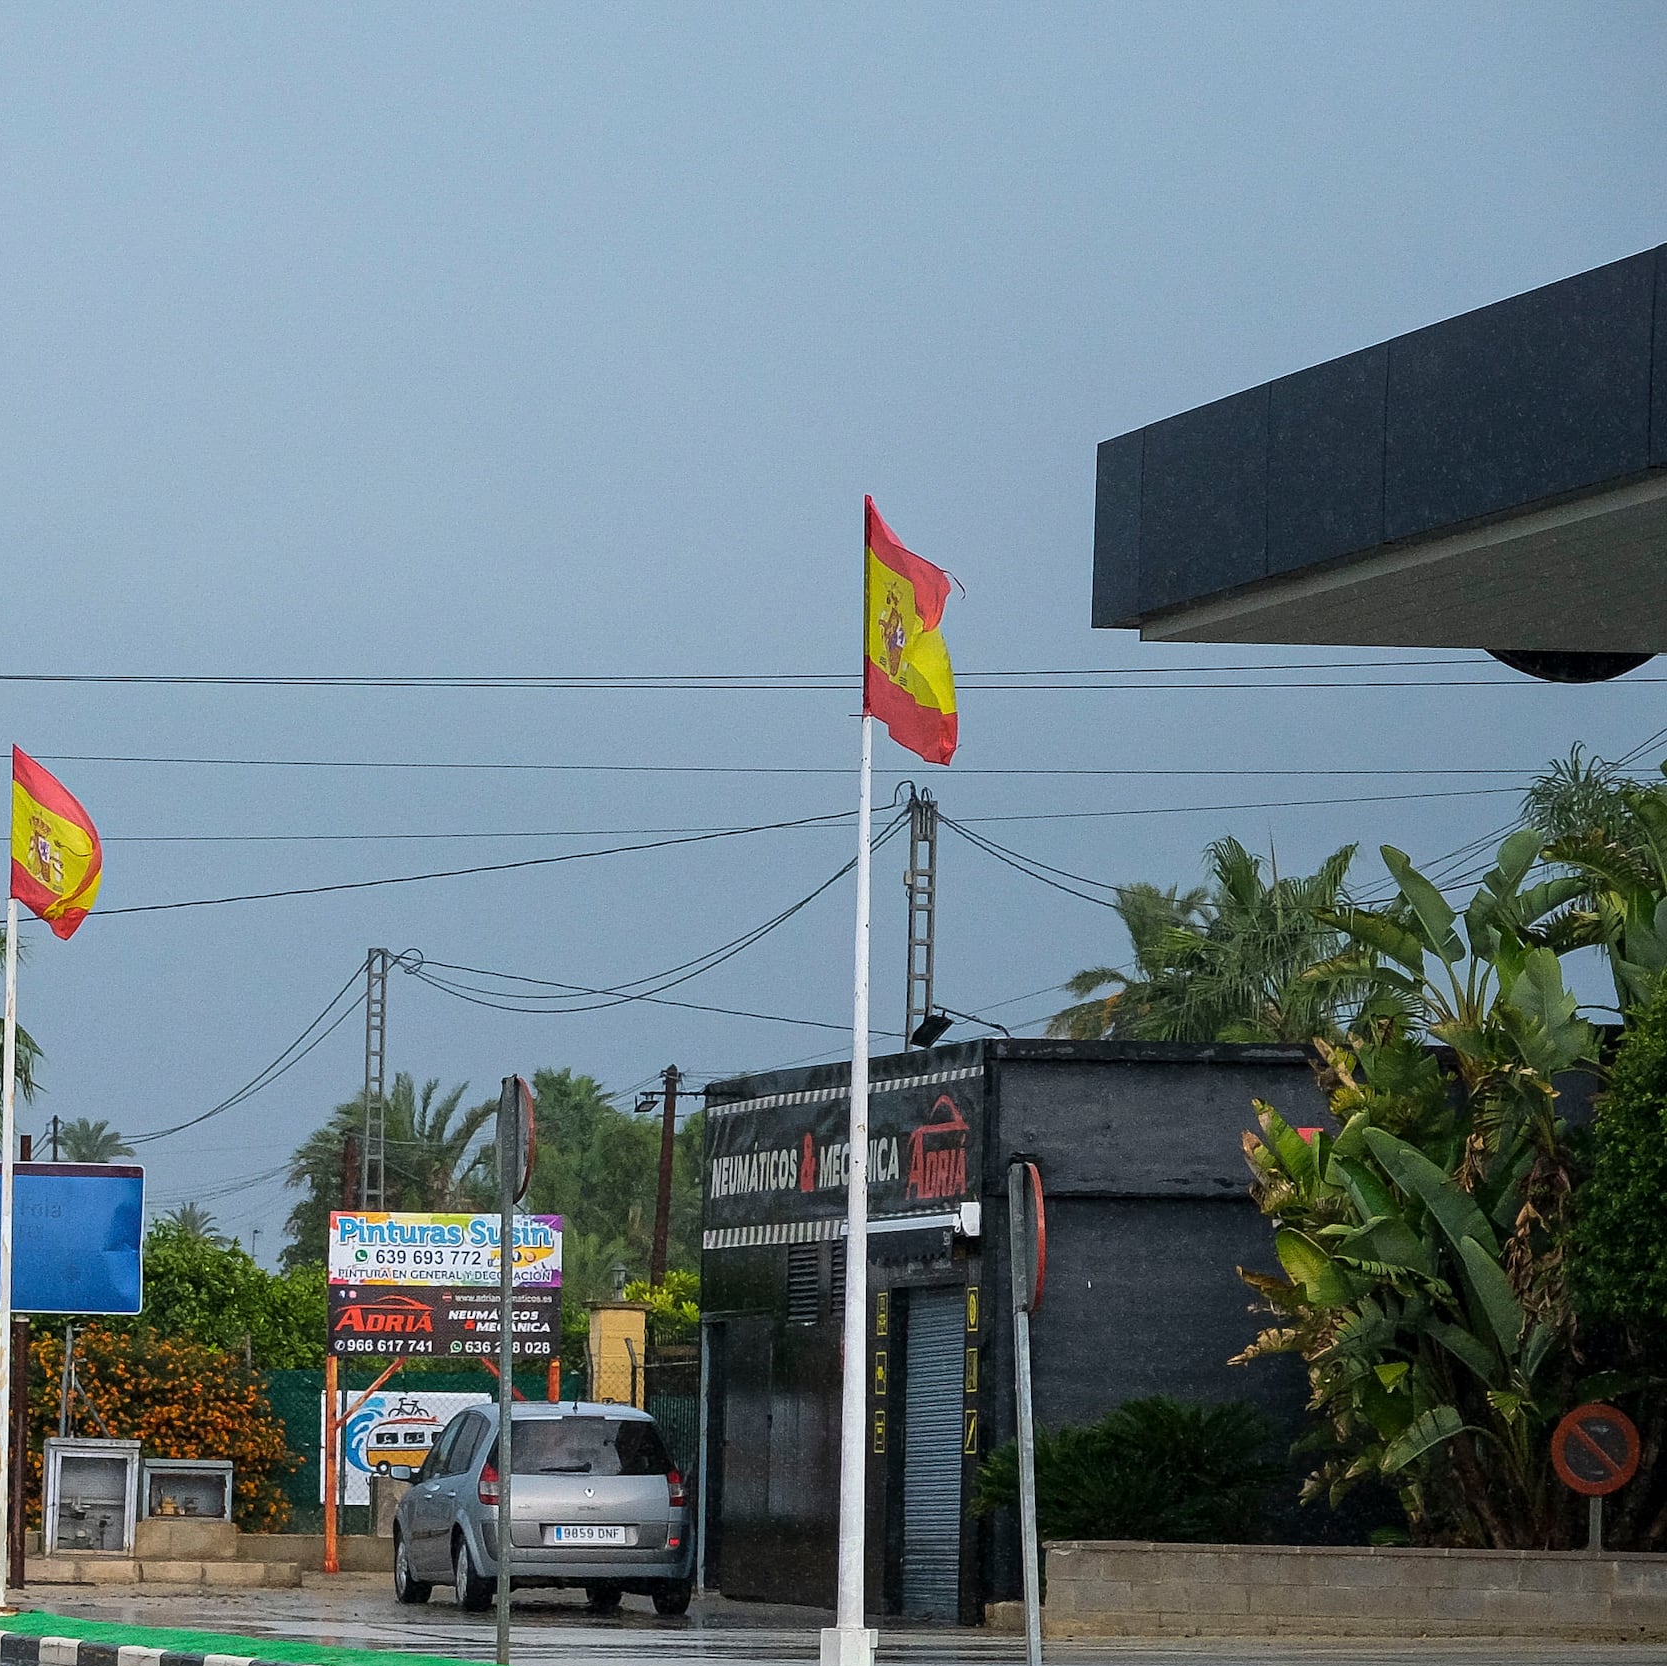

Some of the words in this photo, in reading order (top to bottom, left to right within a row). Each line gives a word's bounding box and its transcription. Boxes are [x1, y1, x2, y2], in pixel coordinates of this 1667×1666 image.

[710, 1142, 798, 1199] NEUMÁTICOS
[800, 1132, 815, 1192] &
[818, 1136, 899, 1188] MECNICA
[338, 1217, 463, 1246] Pinturas
[376, 1250, 407, 1264] 639
[413, 1250, 444, 1265] 693
[451, 1251, 481, 1265] 772
[338, 1268, 389, 1279] PINTURA
[392, 1269, 407, 1279] EN
[410, 1269, 462, 1280] GENERAL
[464, 1271, 472, 1280] Y
[335, 1308, 434, 1333] ADRIÁ
[448, 1308, 539, 1321] NEUMÁCOS
[347, 1340, 373, 1352] 966
[377, 1340, 403, 1353] 617
[407, 1341, 433, 1352] 741
[465, 1341, 491, 1353] 636
[494, 1341, 520, 1353] 28
[525, 1342, 551, 1354] 028
[564, 1528, 594, 1539] 9859
[598, 1529, 619, 1539] DNF
